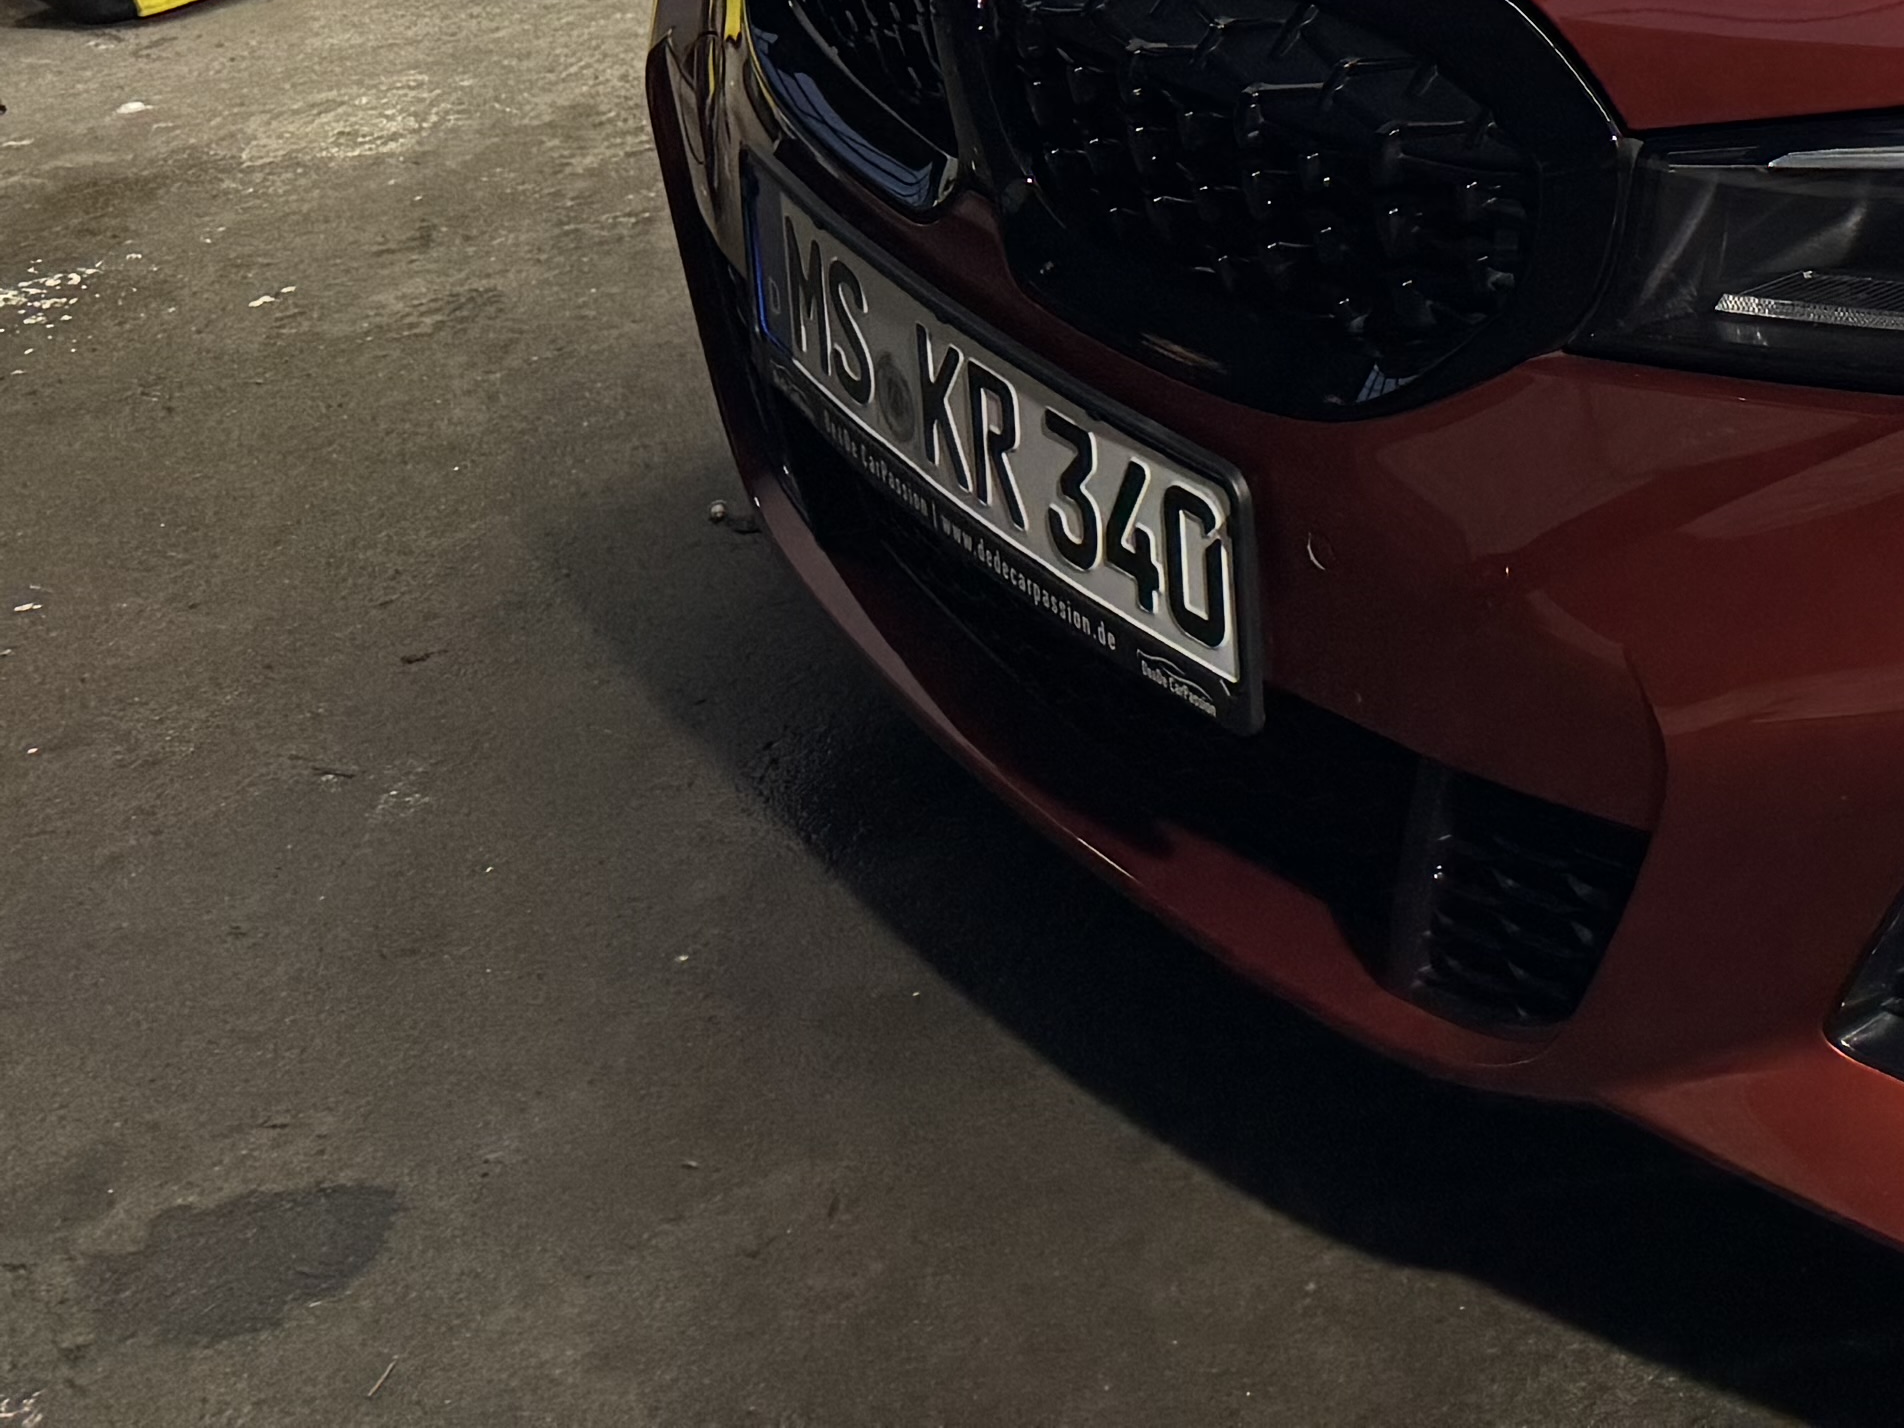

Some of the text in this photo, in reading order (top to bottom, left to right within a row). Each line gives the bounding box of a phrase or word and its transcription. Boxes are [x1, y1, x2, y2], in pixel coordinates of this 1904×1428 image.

[784, 214, 1232, 650] MS KR 340
[860, 443, 929, 517] CarPassion
[941, 513, 1117, 651] www.dedecarpassion.de
